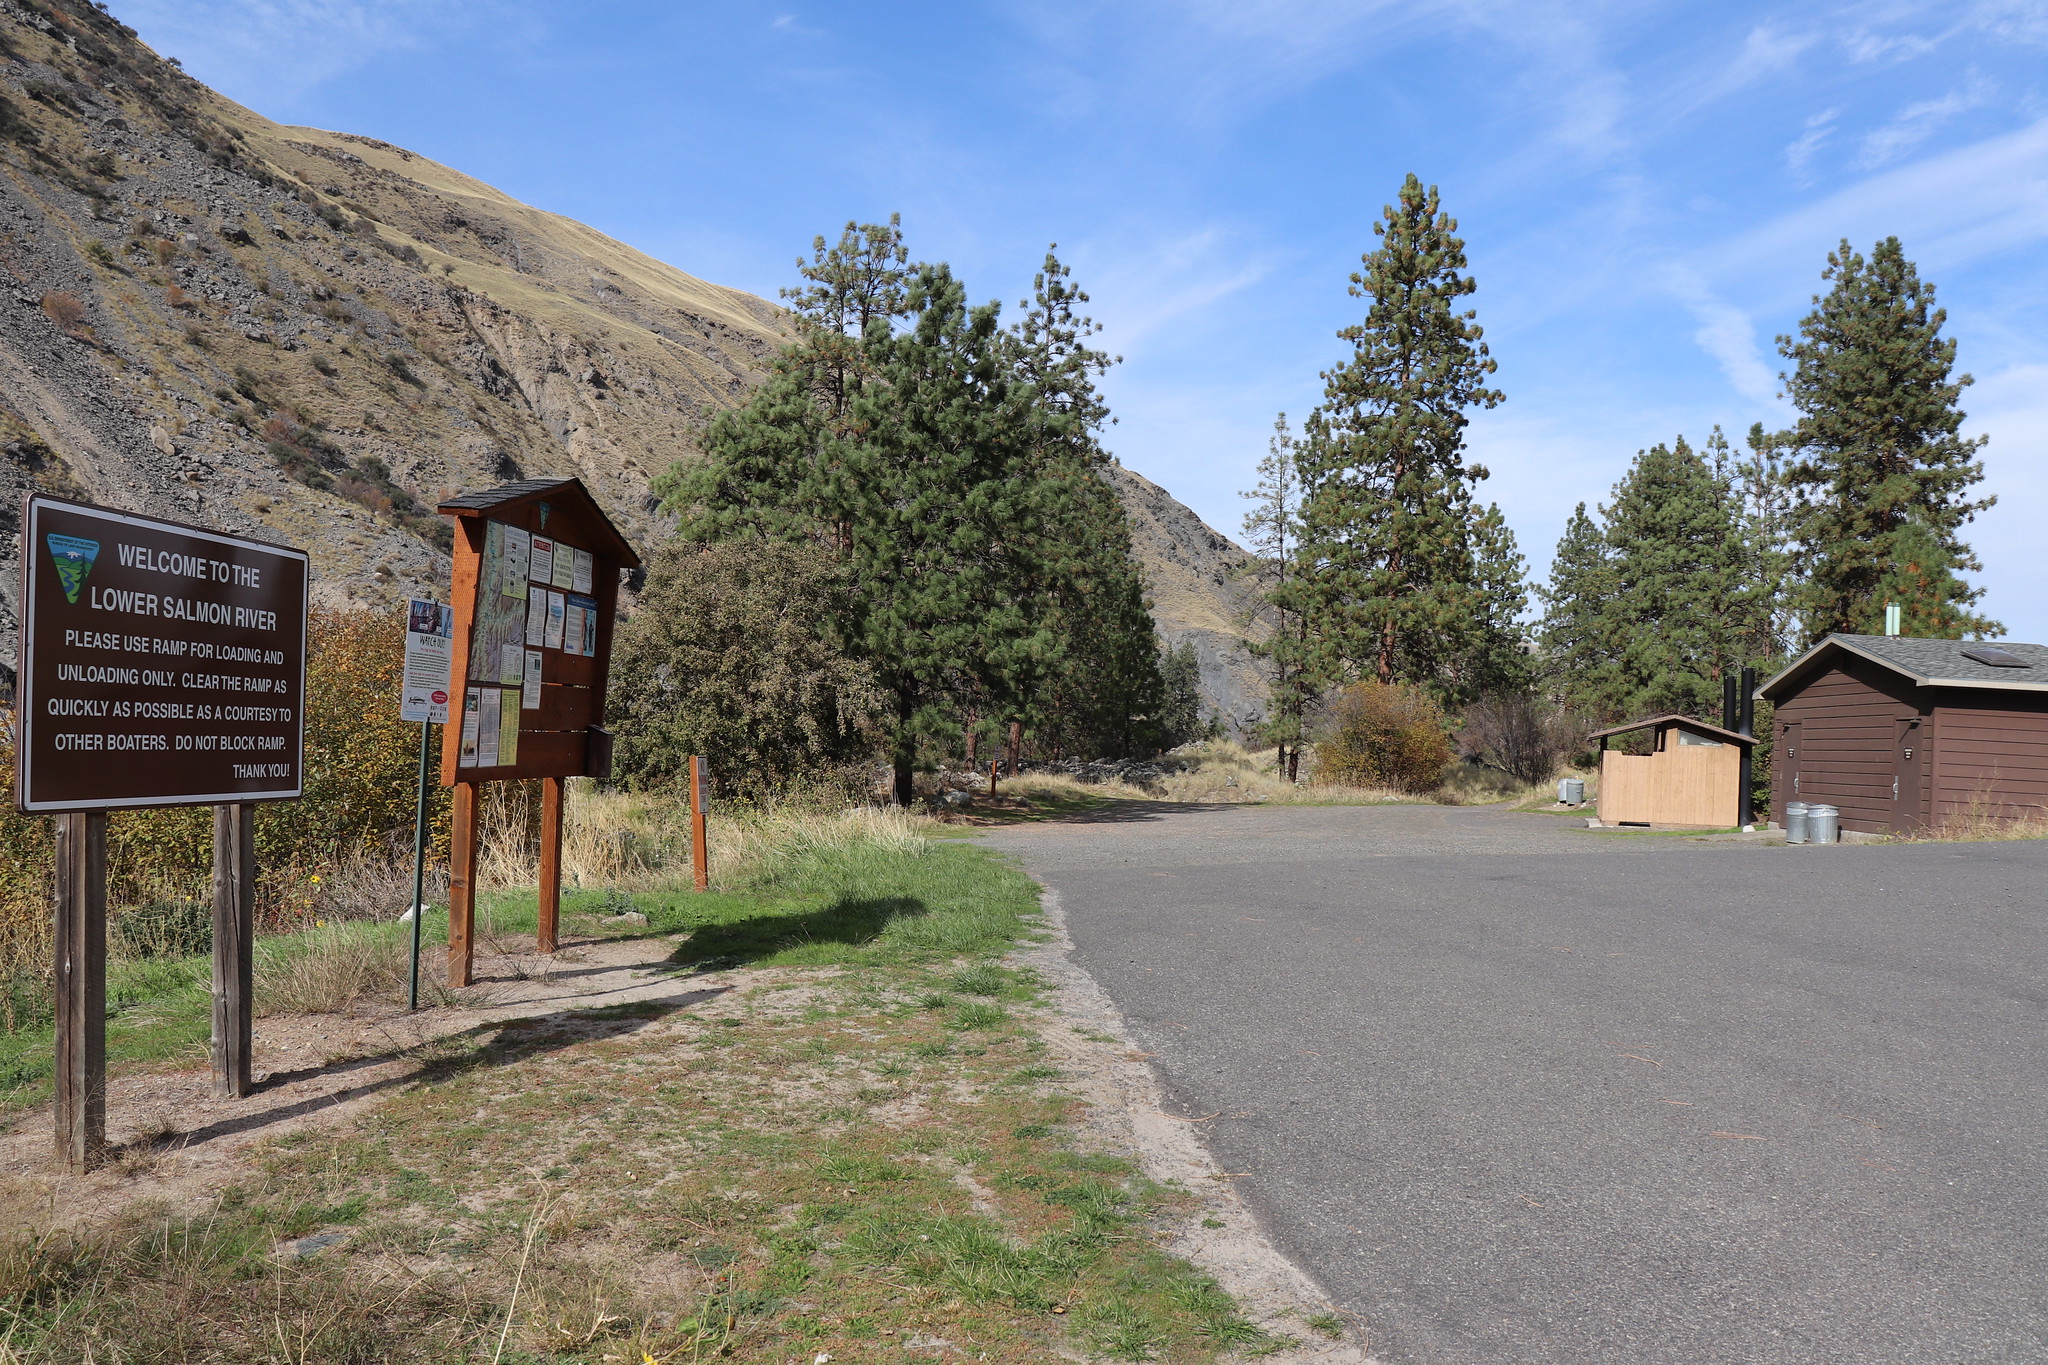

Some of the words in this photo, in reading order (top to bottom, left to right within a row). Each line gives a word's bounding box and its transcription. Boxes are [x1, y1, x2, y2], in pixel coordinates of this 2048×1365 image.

[117, 544, 206, 580] WELCOME
[210, 561, 229, 583] TO
[232, 565, 259, 589] THE
[91, 587, 157, 617] LOWER
[162, 597, 230, 626] SALMON
[235, 607, 276, 632] RIVER
[65, 630, 119, 651] PLEASE
[124, 636, 149, 653] USE
[153, 639, 187, 656] RAMP
[190, 643, 213, 659] FOR
[216, 646, 261, 663] LOADING
[263, 651, 283, 665] AND
[58, 664, 138, 685] UNLOADING
[142, 670, 176, 687] ONLY.
[181, 673, 219, 690] CLEAR
[221, 676, 241, 691] THE
[243, 678, 271, 693] RAMP
[273, 680, 286, 694] AS
[47, 699, 109, 717] QUICKLY
[112, 702, 130, 718] AS
[134, 703, 193, 719] POSSIBLE
[196, 705, 211, 720] AS
[215, 706, 221, 720] A
[224, 706, 277, 722] COURTESY
[279, 709, 291, 723] TO
[55, 734, 103, 751] OTHER
[107, 735, 170, 751] BOATERS.
[175, 736, 192, 751] DO
[195, 736, 217, 751] NOT
[220, 736, 255, 751] BLOCK
[257, 737, 286, 750] RAMP.
[232, 764, 266, 779] THANK
[267, 764, 290, 778] YOU!
